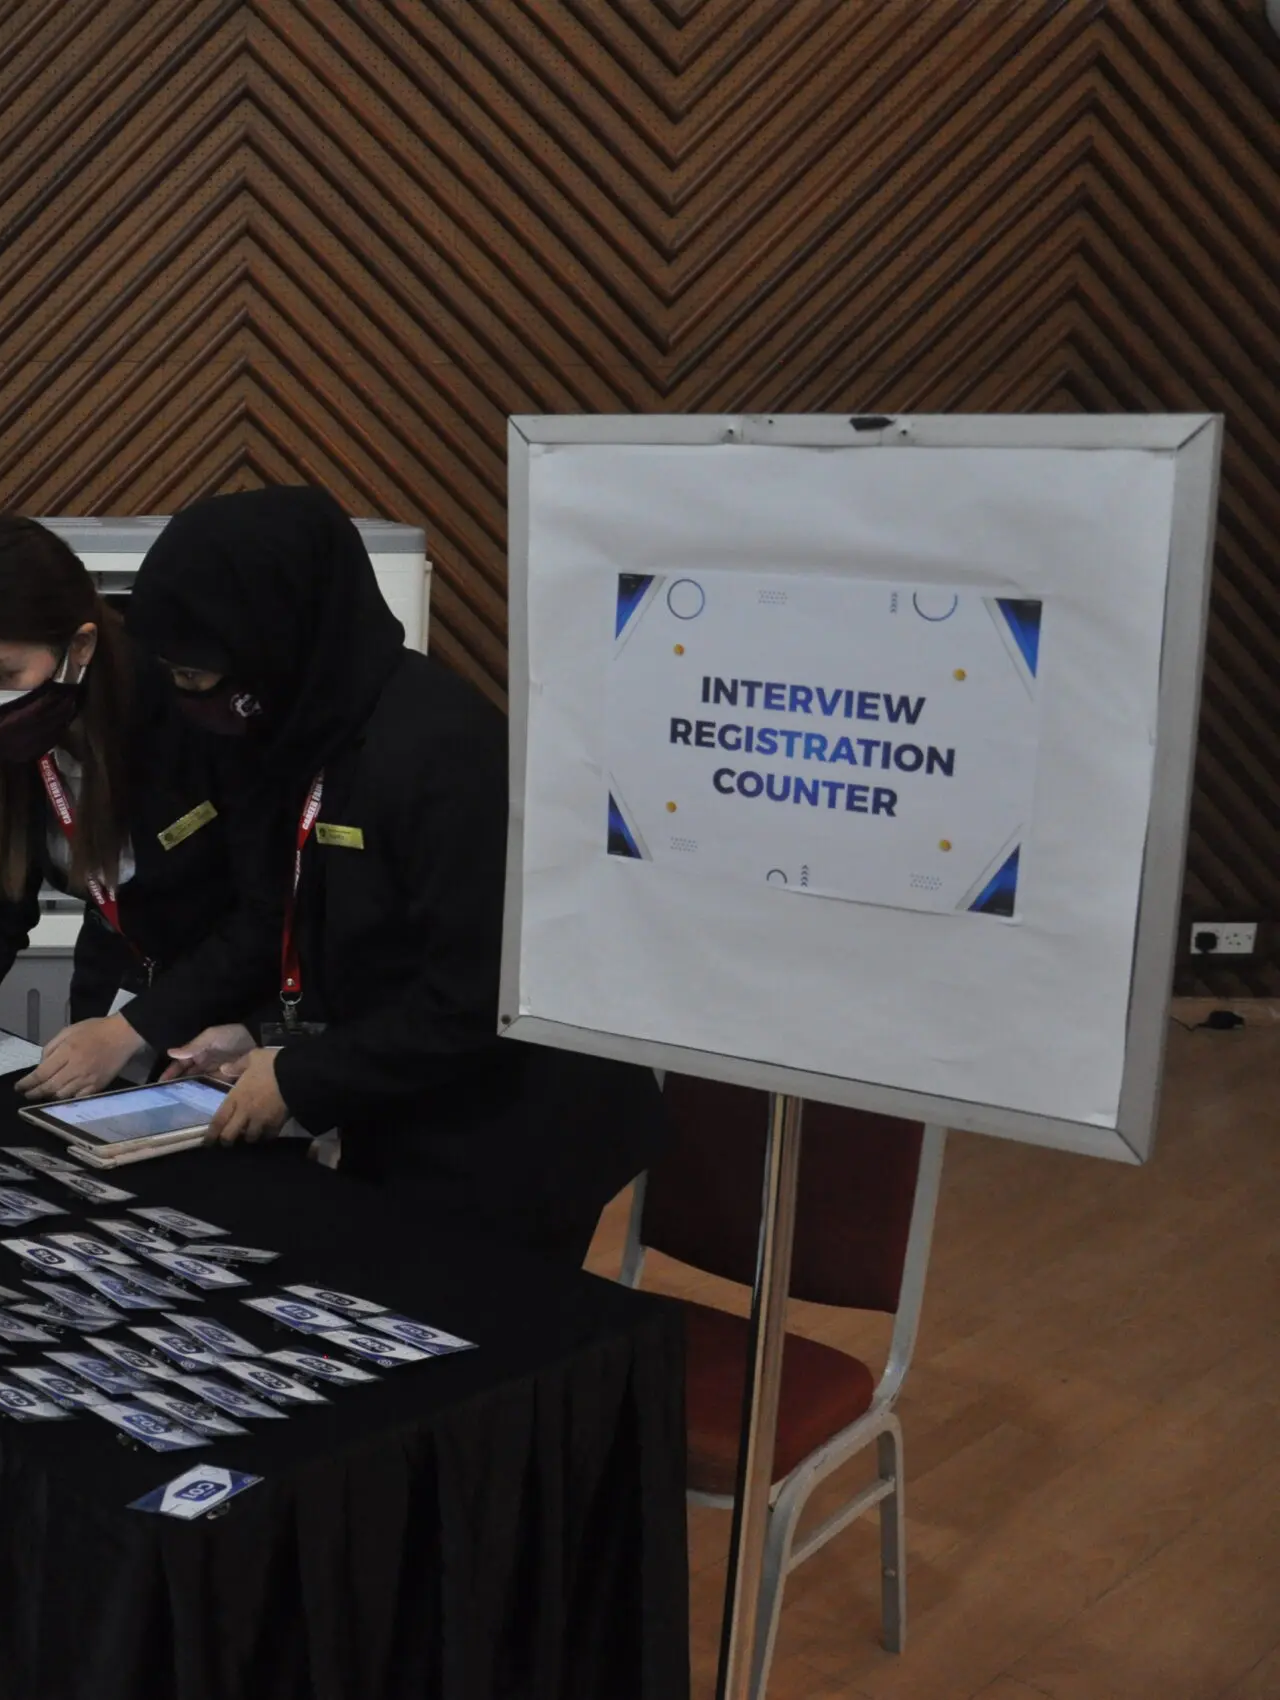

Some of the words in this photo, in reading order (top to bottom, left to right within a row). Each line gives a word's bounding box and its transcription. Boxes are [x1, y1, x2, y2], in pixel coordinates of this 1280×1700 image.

[701, 675, 927, 726] INTERVIEW
[668, 717, 956, 777] REGISTRATION
[712, 767, 898, 818] COUNTER
